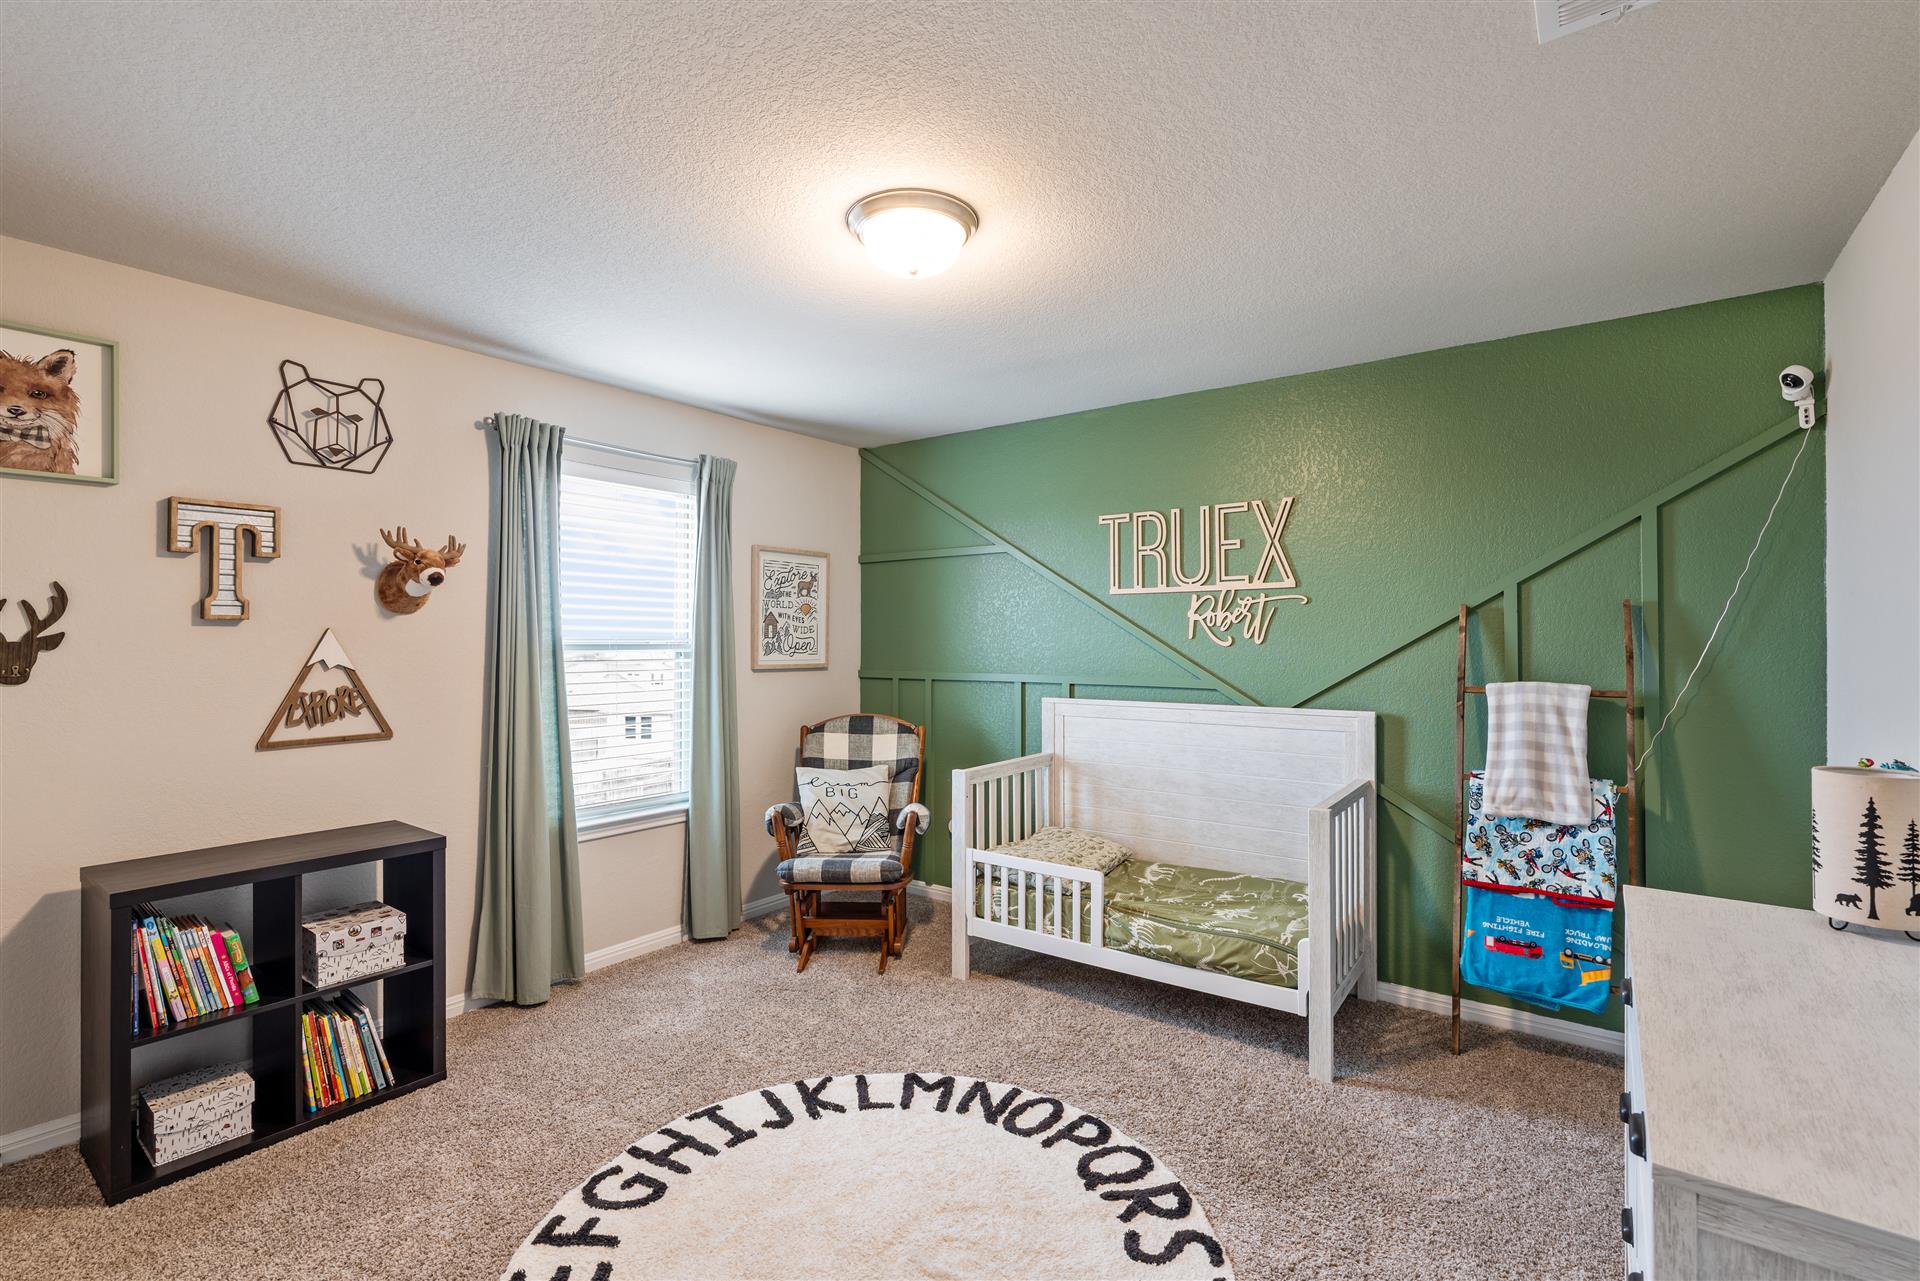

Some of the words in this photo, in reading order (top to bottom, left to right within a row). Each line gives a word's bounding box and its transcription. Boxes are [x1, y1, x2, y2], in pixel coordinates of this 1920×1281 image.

[1099, 497, 1296, 594] TRUEX
[167, 496, 280, 620] T
[764, 566, 808, 592] Explore
[763, 600, 794, 609] WORLD
[778, 612, 791, 620] WITH
[792, 615, 805, 624] EYES
[1187, 590, 1308, 646] Robert
[792, 624, 815, 635] WIDE
[783, 633, 815, 657] Open
[285, 686, 368, 730] EXPLORE
[825, 787, 858, 799] BIG
[1482, 921, 1523, 935] FIGHTING
[1496, 916, 1530, 928] VEHICLE
[1526, 929, 1545, 938] FIRE
[1564, 928, 1592, 940] TRUCK
[1594, 934, 1612, 943] UMP
[1566, 936, 1612, 952] NLOADING
